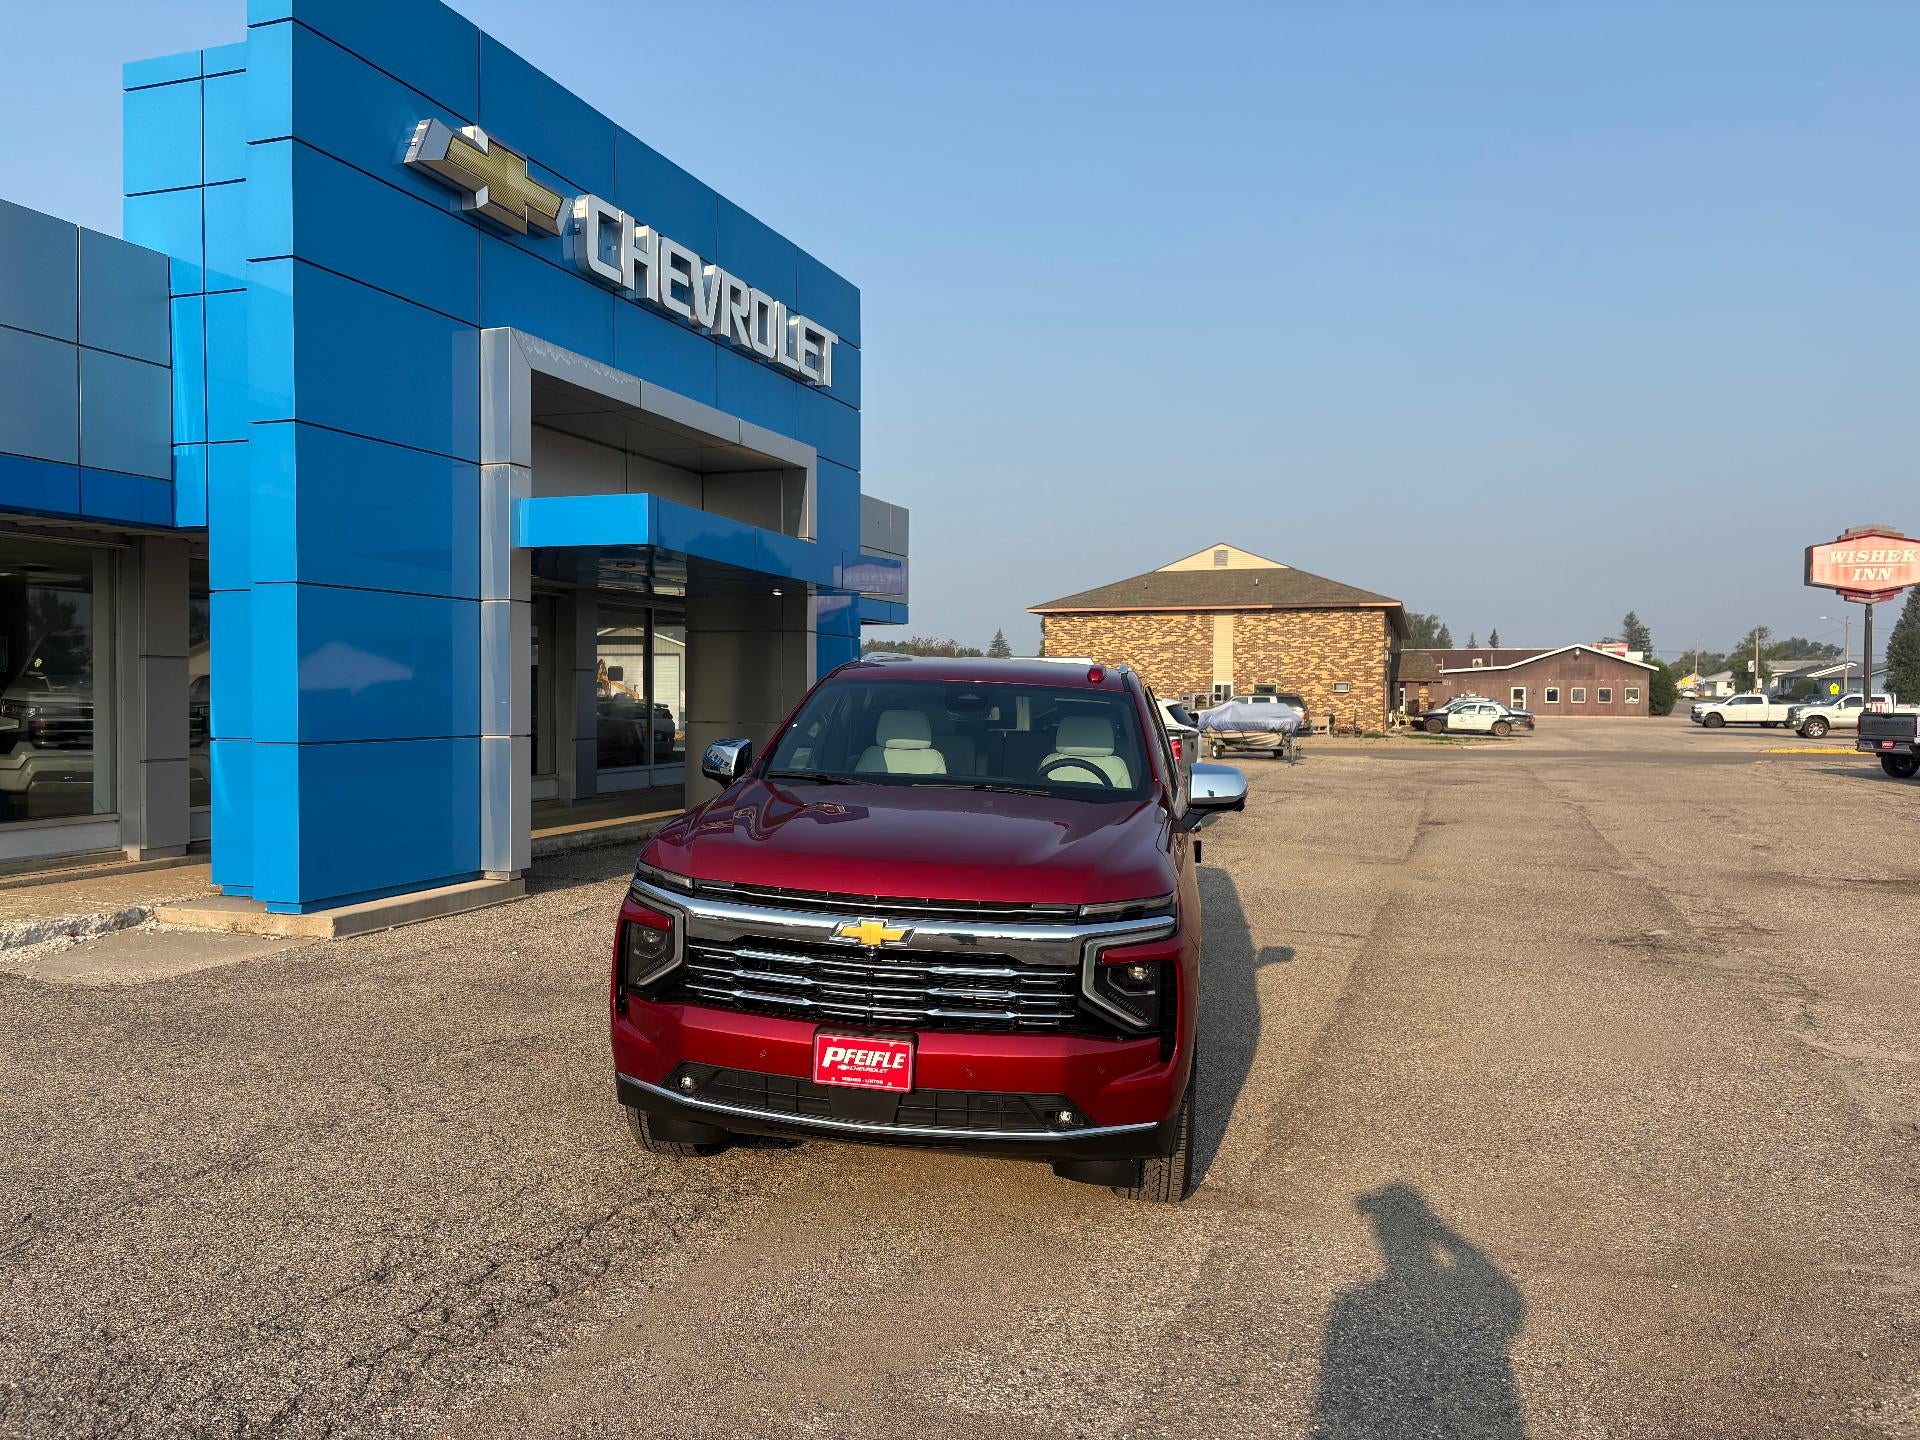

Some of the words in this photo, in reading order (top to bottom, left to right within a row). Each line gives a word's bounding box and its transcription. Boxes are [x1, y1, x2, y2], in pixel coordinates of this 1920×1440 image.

[574, 194, 839, 388] CHEVROLET
[1829, 549, 1918, 563] WISHEK
[1852, 567, 1893, 581] INN
[821, 1046, 906, 1069] PFEIFLE
[849, 1065, 888, 1074] CHEVROLET
